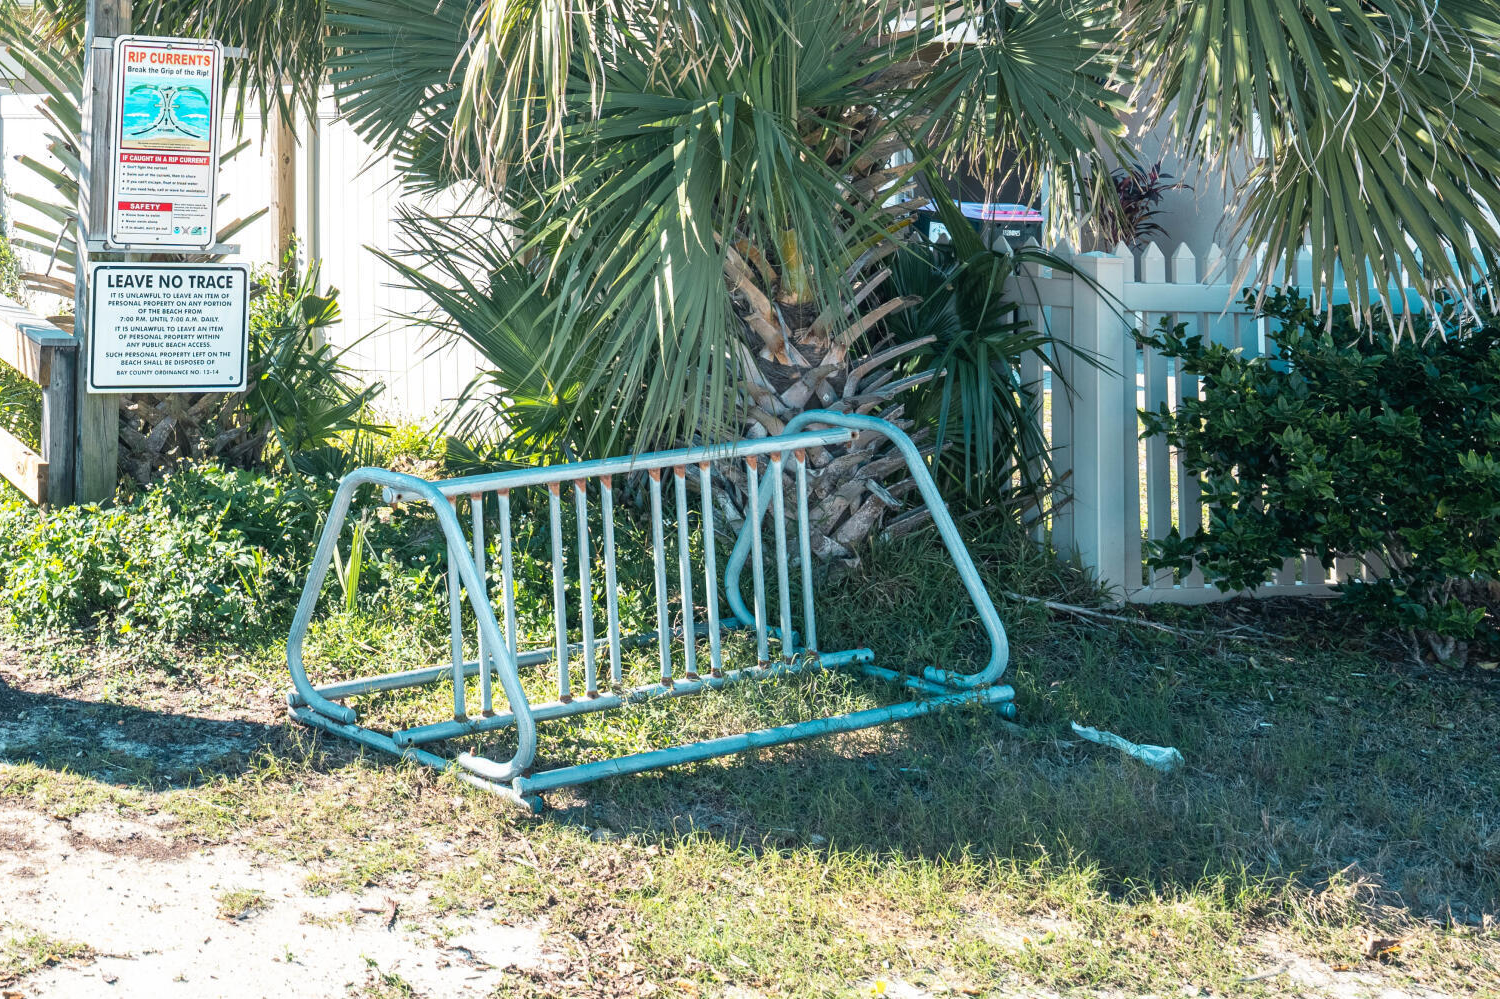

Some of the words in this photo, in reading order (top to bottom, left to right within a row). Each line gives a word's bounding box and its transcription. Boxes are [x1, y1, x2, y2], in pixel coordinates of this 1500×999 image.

[128, 51, 146, 63] RIP
[150, 52, 210, 66] CURRENTS
[108, 274, 153, 288] LEAVE
[159, 274, 183, 288] NO
[188, 275, 233, 288] TRACE
